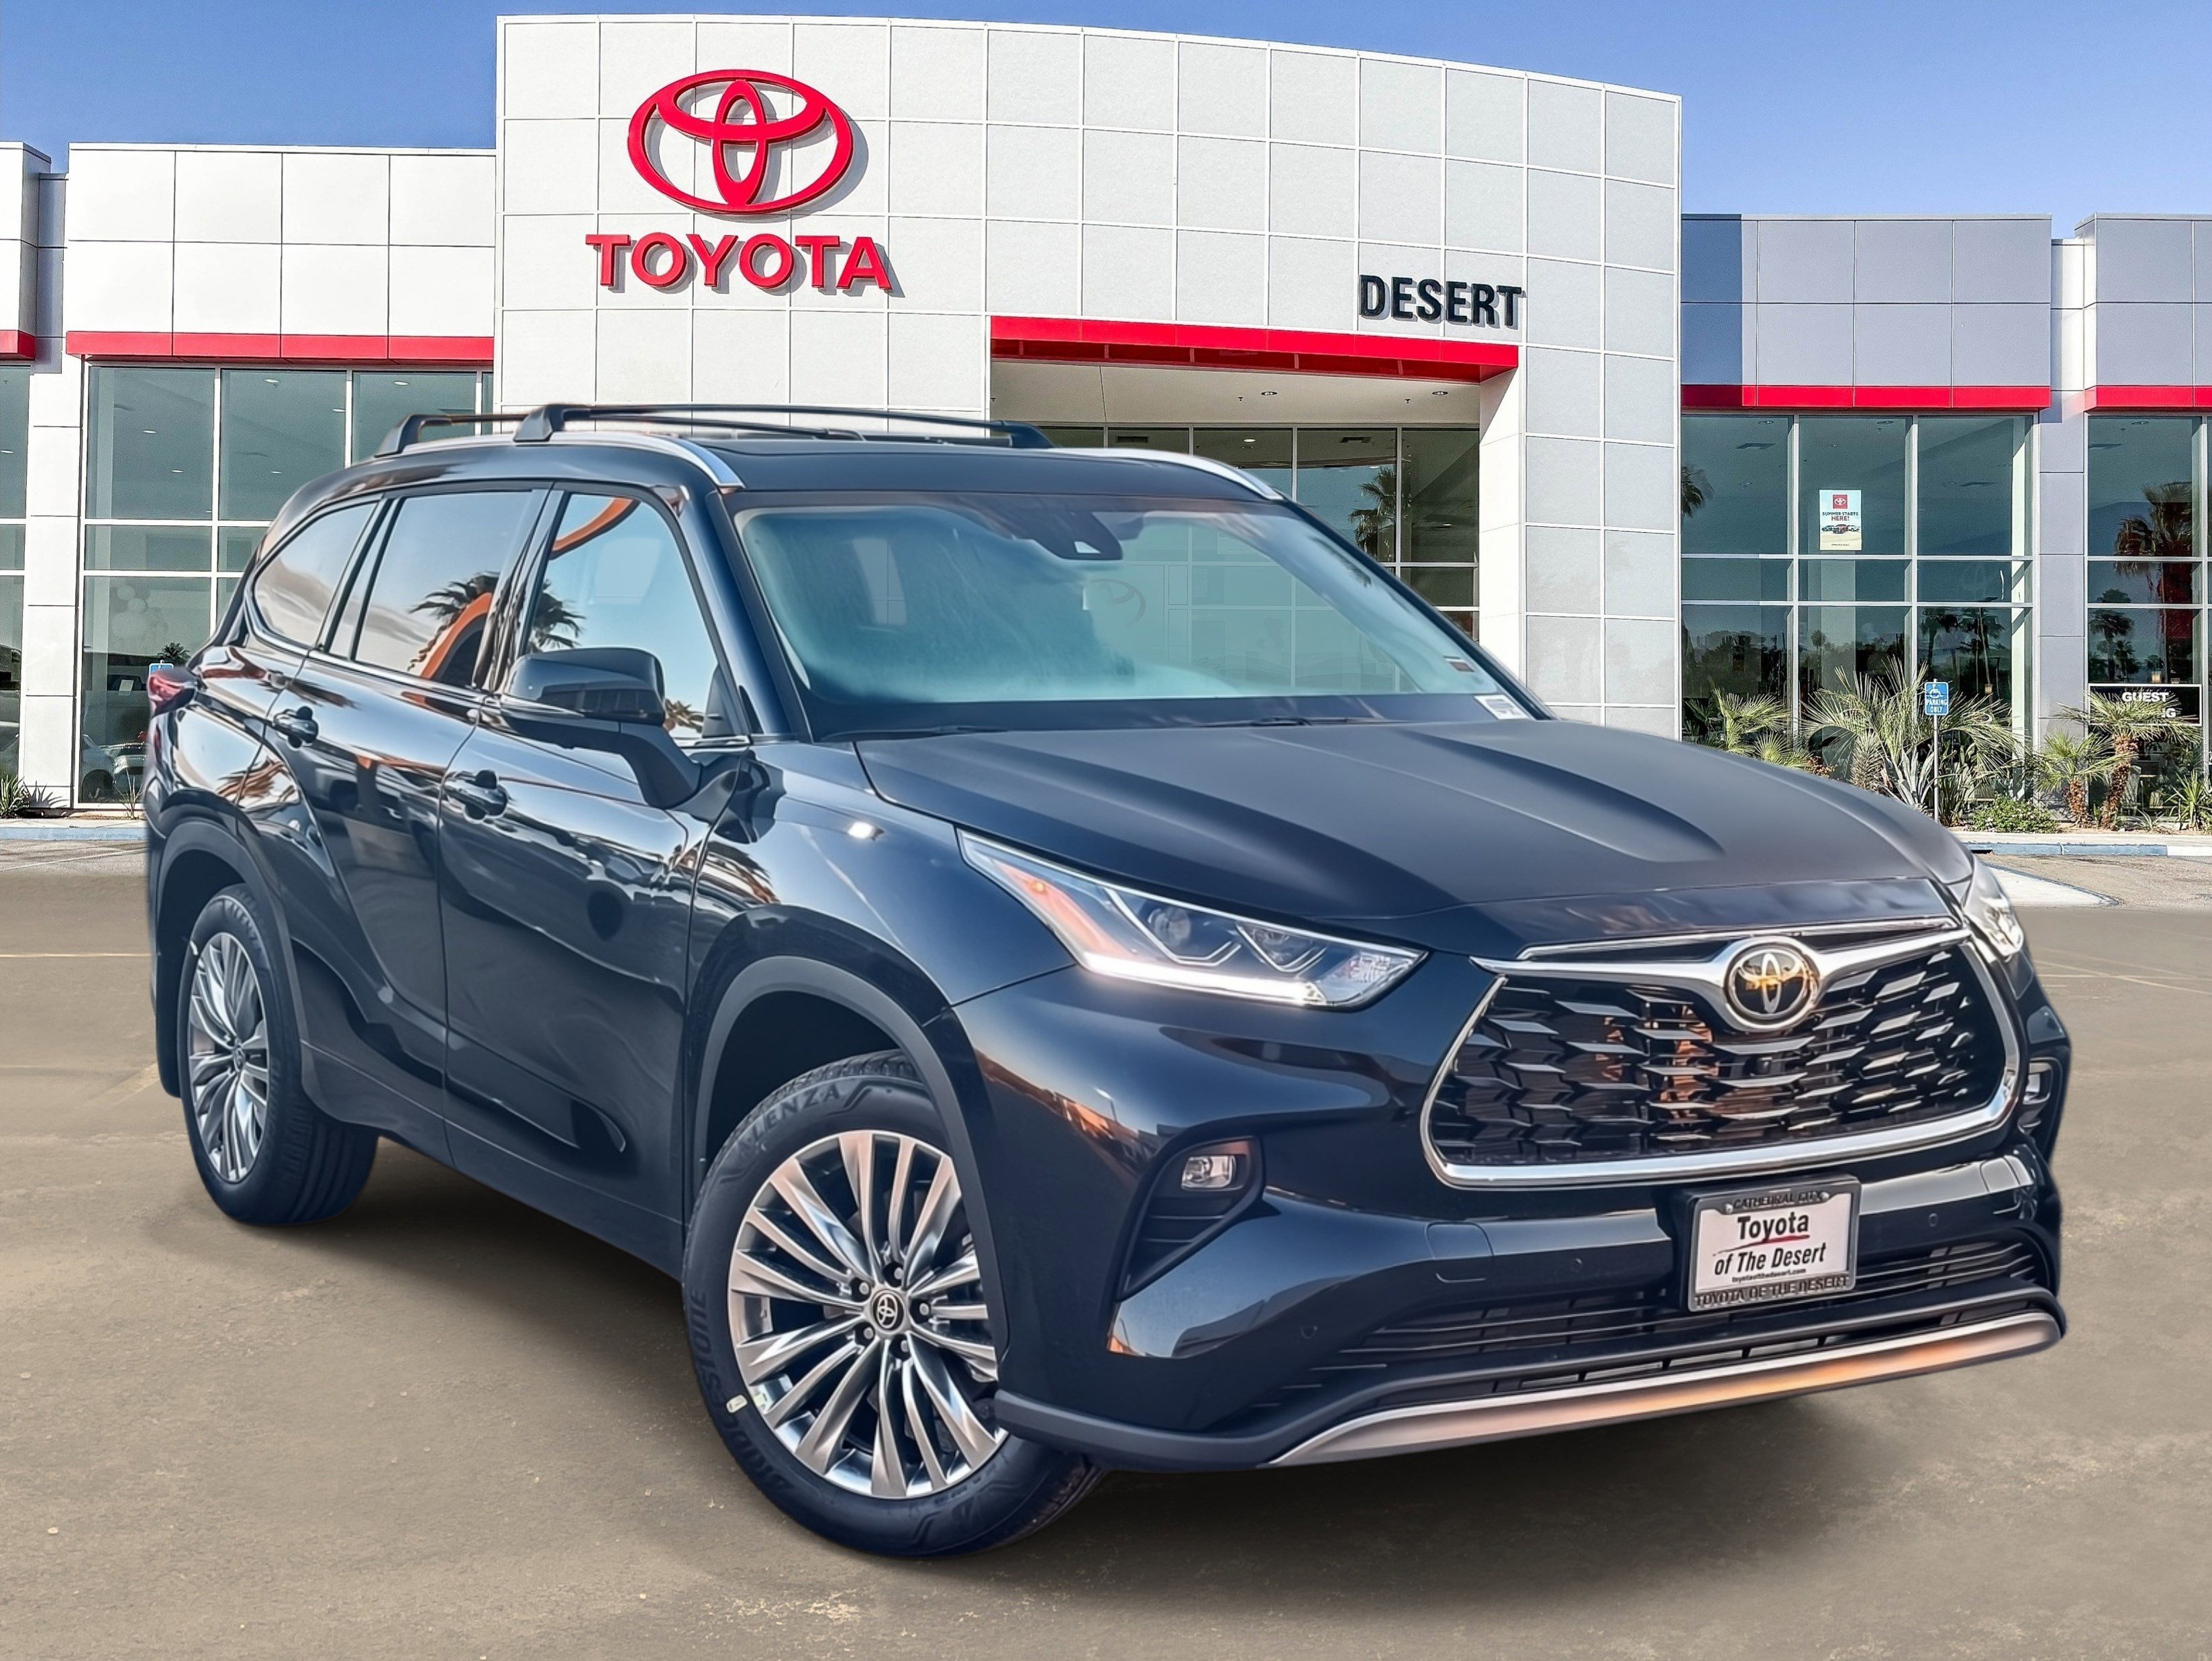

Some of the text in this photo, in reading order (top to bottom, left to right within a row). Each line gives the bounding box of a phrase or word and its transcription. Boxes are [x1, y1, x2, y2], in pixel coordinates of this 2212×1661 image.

[585, 232, 893, 291] TOYOTA
[1359, 274, 1522, 327] DESERT
[2121, 691, 2169, 703] GUEST
[1738, 1211, 1809, 1242] Toyota
[1715, 1242, 1826, 1275] of The Desert
[1695, 1276, 1848, 1307] TOYOTA OF THE DESERT
